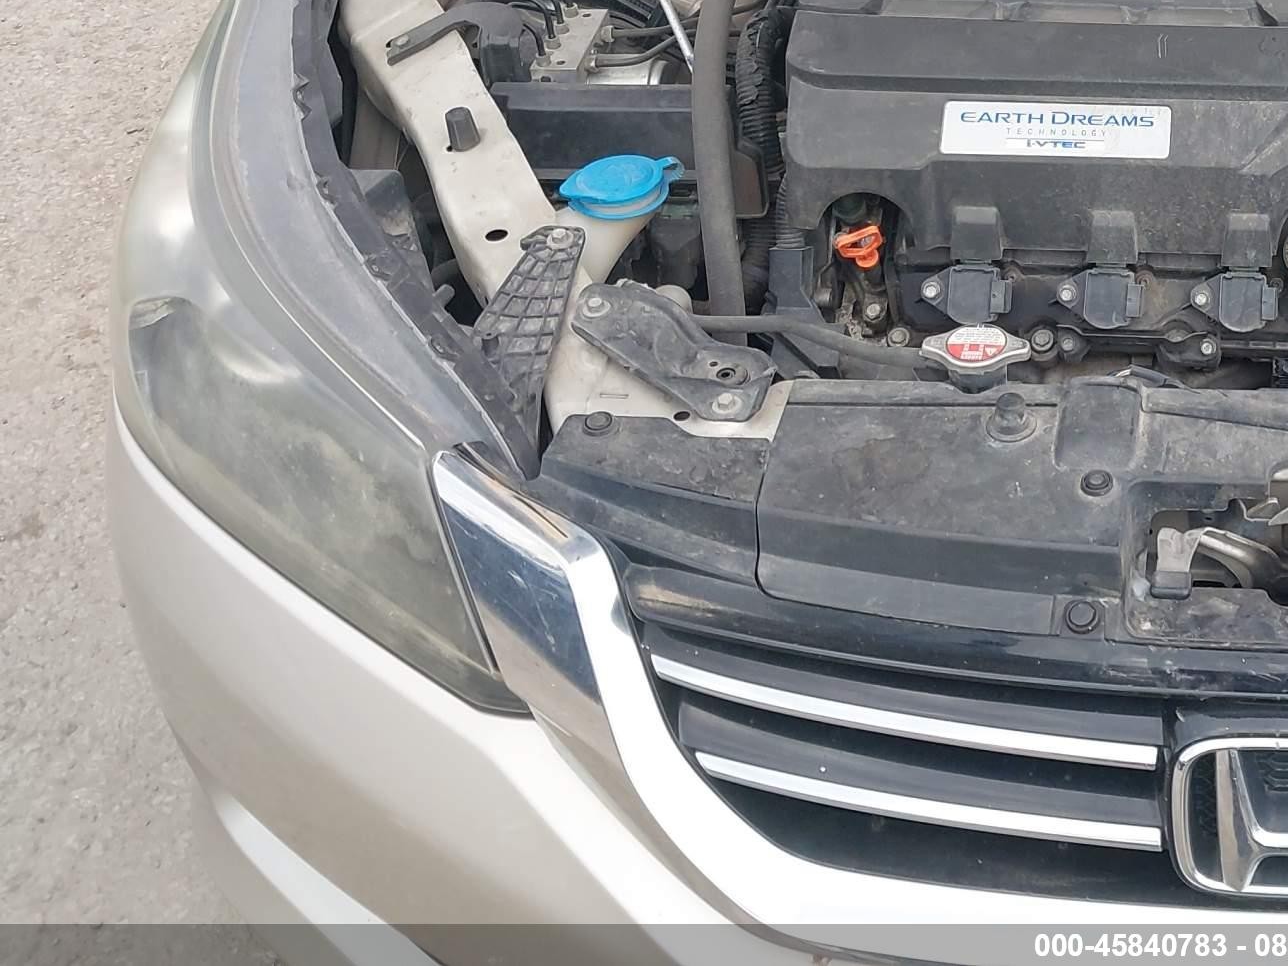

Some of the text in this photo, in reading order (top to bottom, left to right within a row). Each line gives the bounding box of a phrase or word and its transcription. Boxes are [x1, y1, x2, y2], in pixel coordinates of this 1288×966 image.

[960, 111, 1154, 127] EARTH DREAMS
[1006, 128, 1106, 137] TECHNOLOGY
